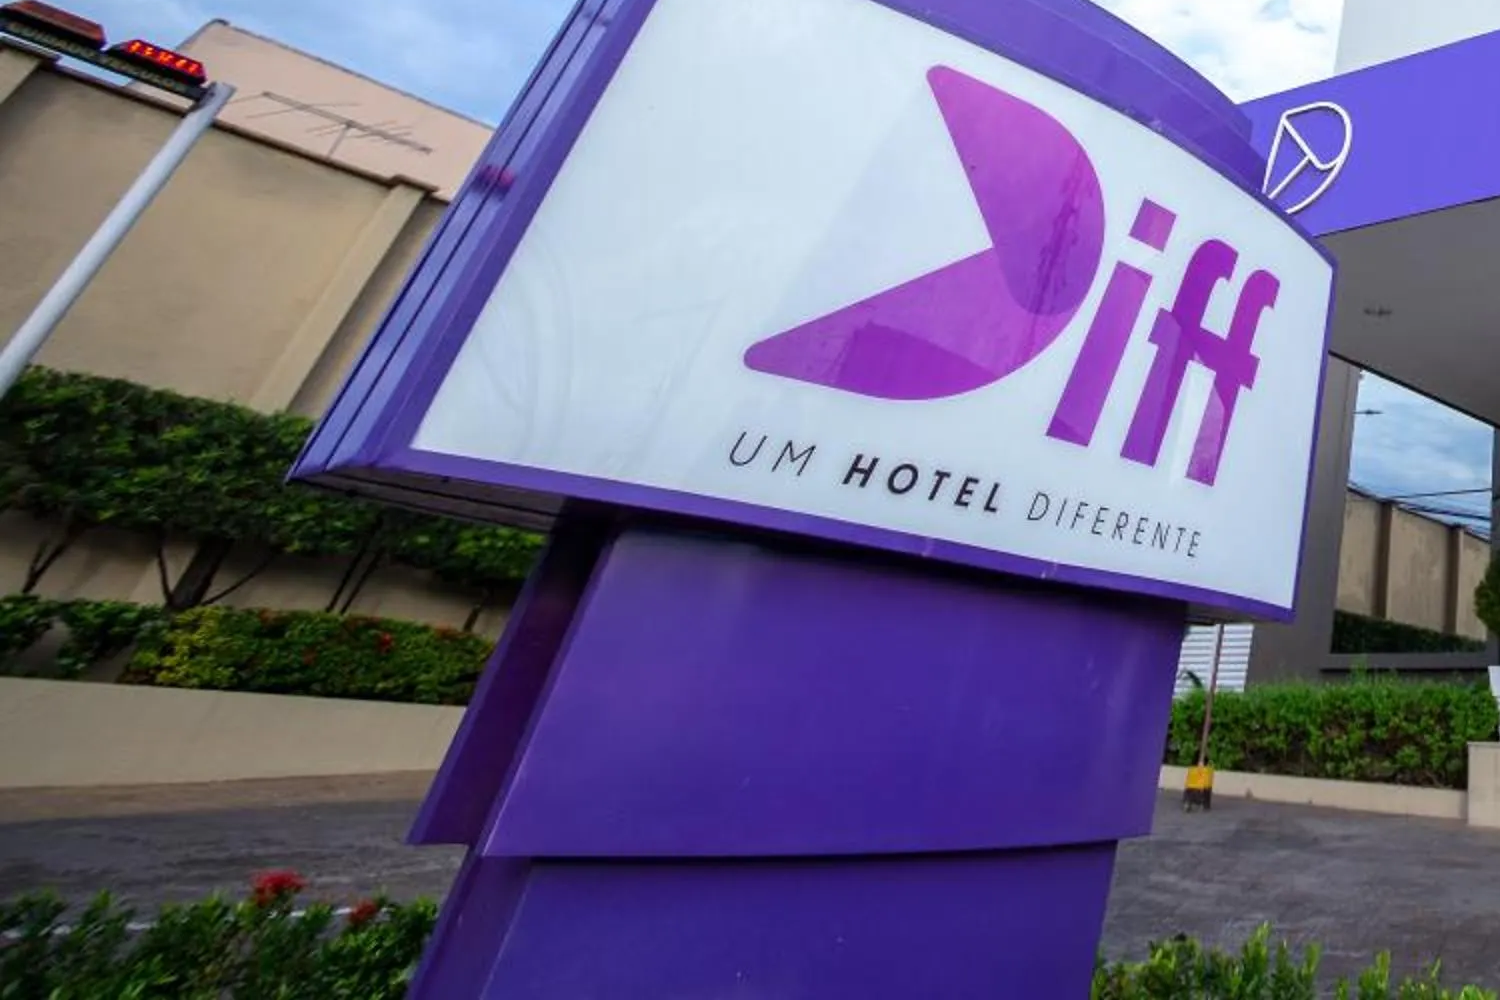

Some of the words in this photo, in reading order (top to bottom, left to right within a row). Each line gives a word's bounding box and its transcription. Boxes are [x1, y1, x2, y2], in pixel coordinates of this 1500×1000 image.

[743, 64, 1280, 487] Diff
[729, 431, 816, 476] UM
[842, 453, 1000, 514] HOTEL
[1027, 491, 1202, 558] DIFERENTE
